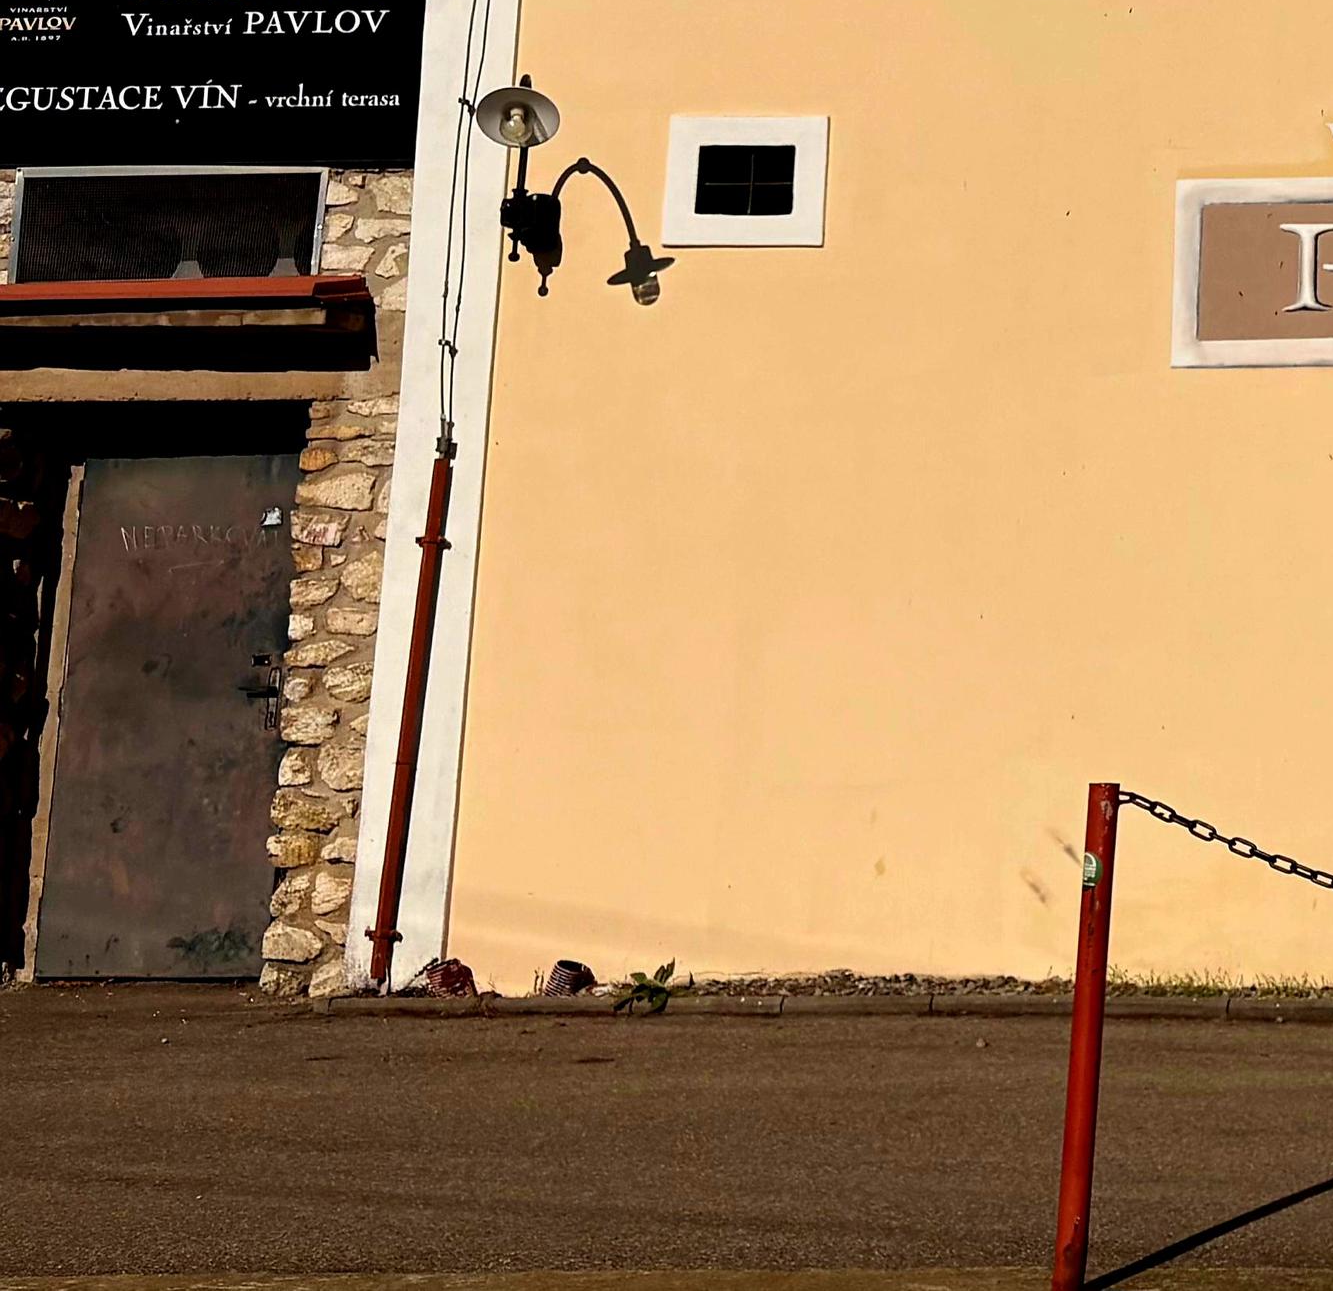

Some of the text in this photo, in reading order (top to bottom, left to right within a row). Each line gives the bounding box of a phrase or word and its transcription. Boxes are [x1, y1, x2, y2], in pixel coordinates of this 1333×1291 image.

[0, 16, 77, 31] PAVLOV
[120, 9, 391, 37] Vinařství PAVLOV
[0, 85, 164, 112] GUSTACE
[170, 78, 243, 110] VÍN
[264, 82, 334, 108] vrchní
[341, 92, 401, 107] terasa
